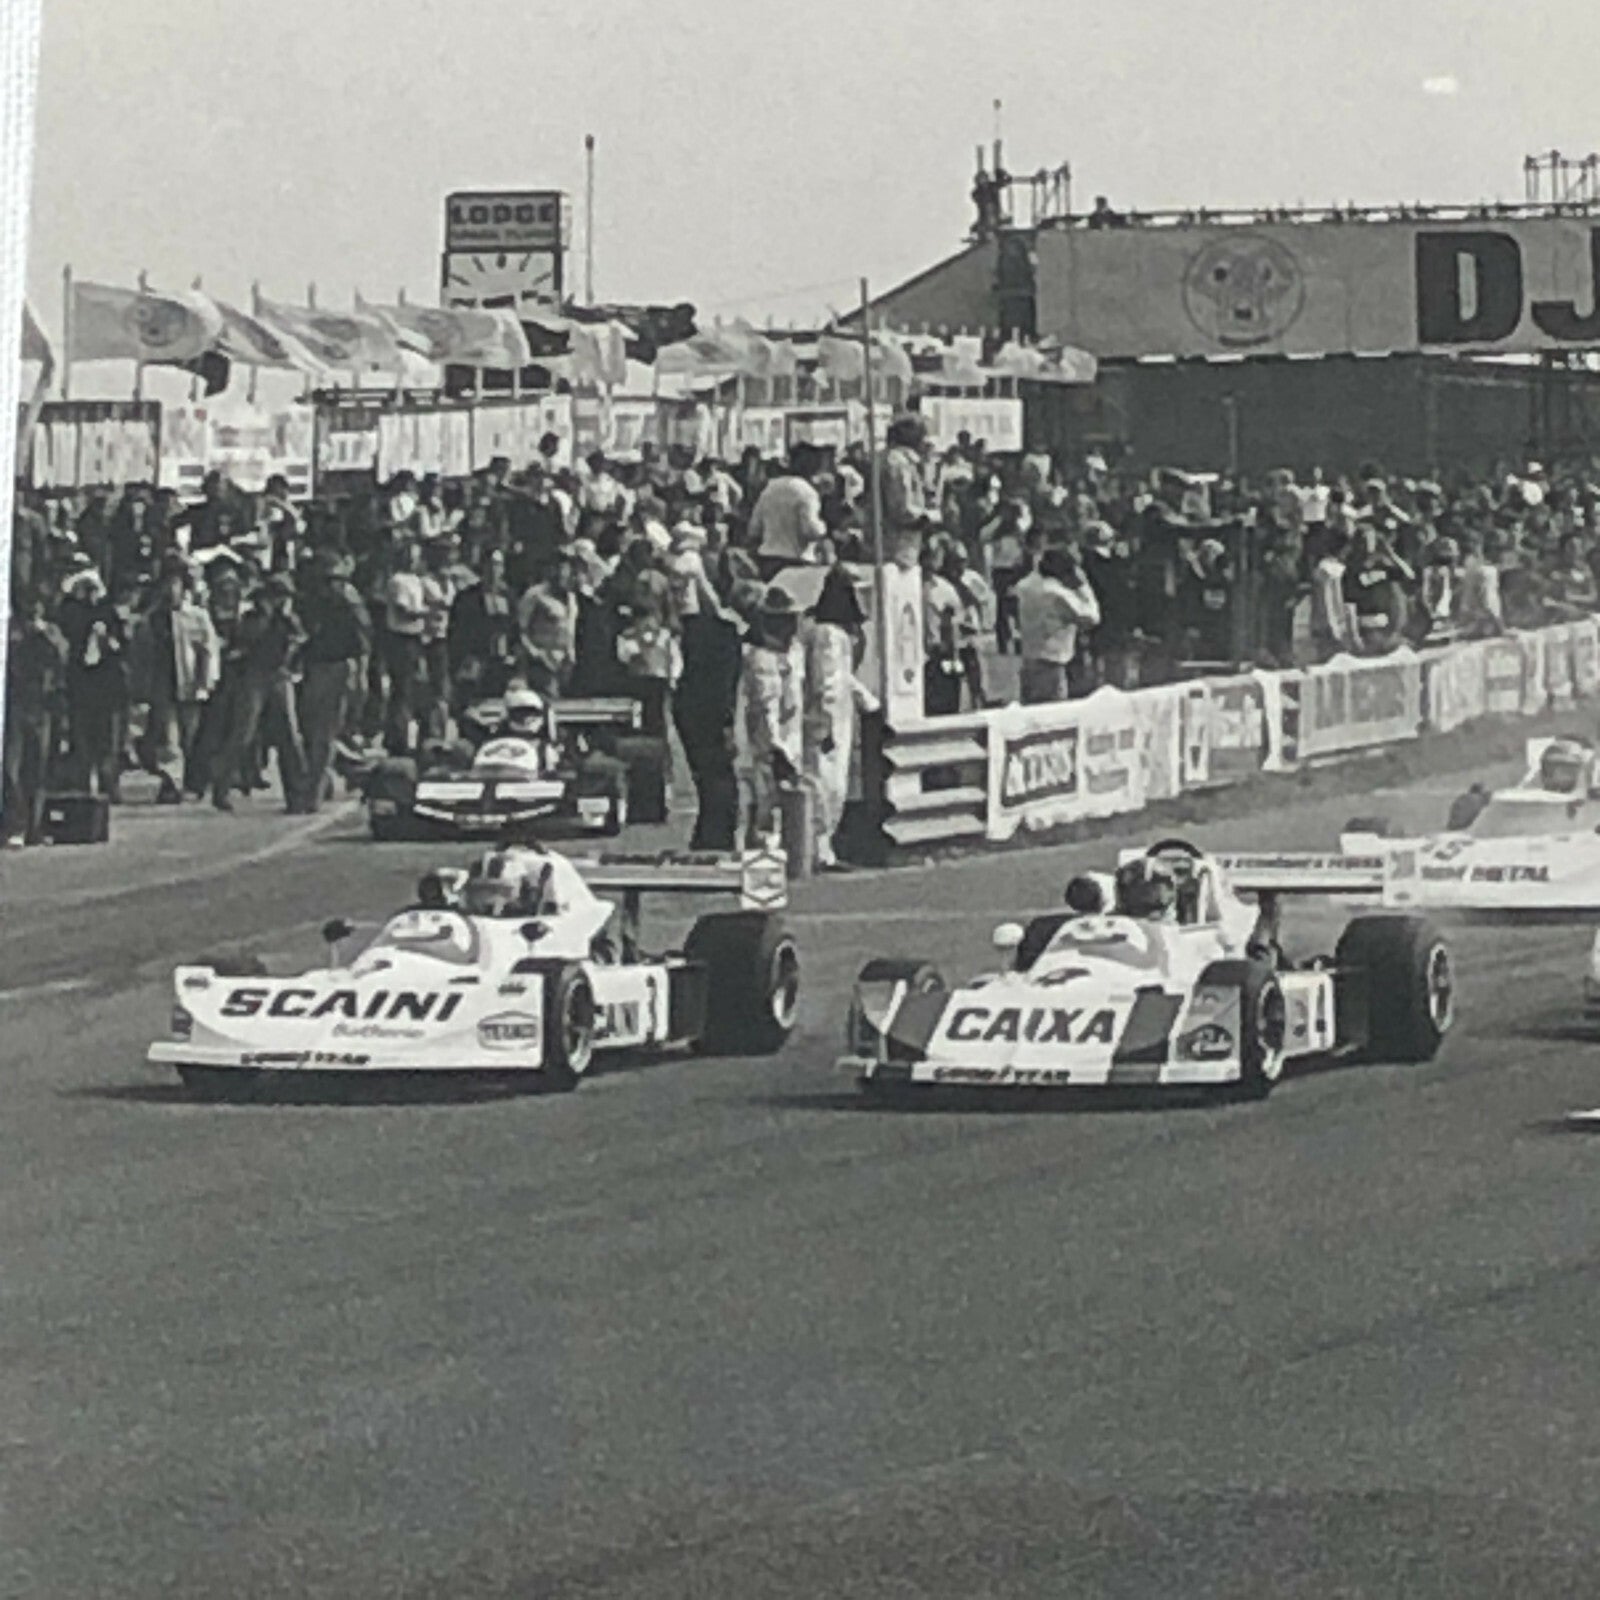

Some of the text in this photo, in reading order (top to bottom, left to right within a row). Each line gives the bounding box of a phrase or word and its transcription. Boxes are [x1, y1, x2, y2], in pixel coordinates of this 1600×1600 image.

[450, 203, 556, 225] LODGE
[220, 988, 464, 1022] SCAINI
[946, 1007, 1117, 1043] CAIXA
